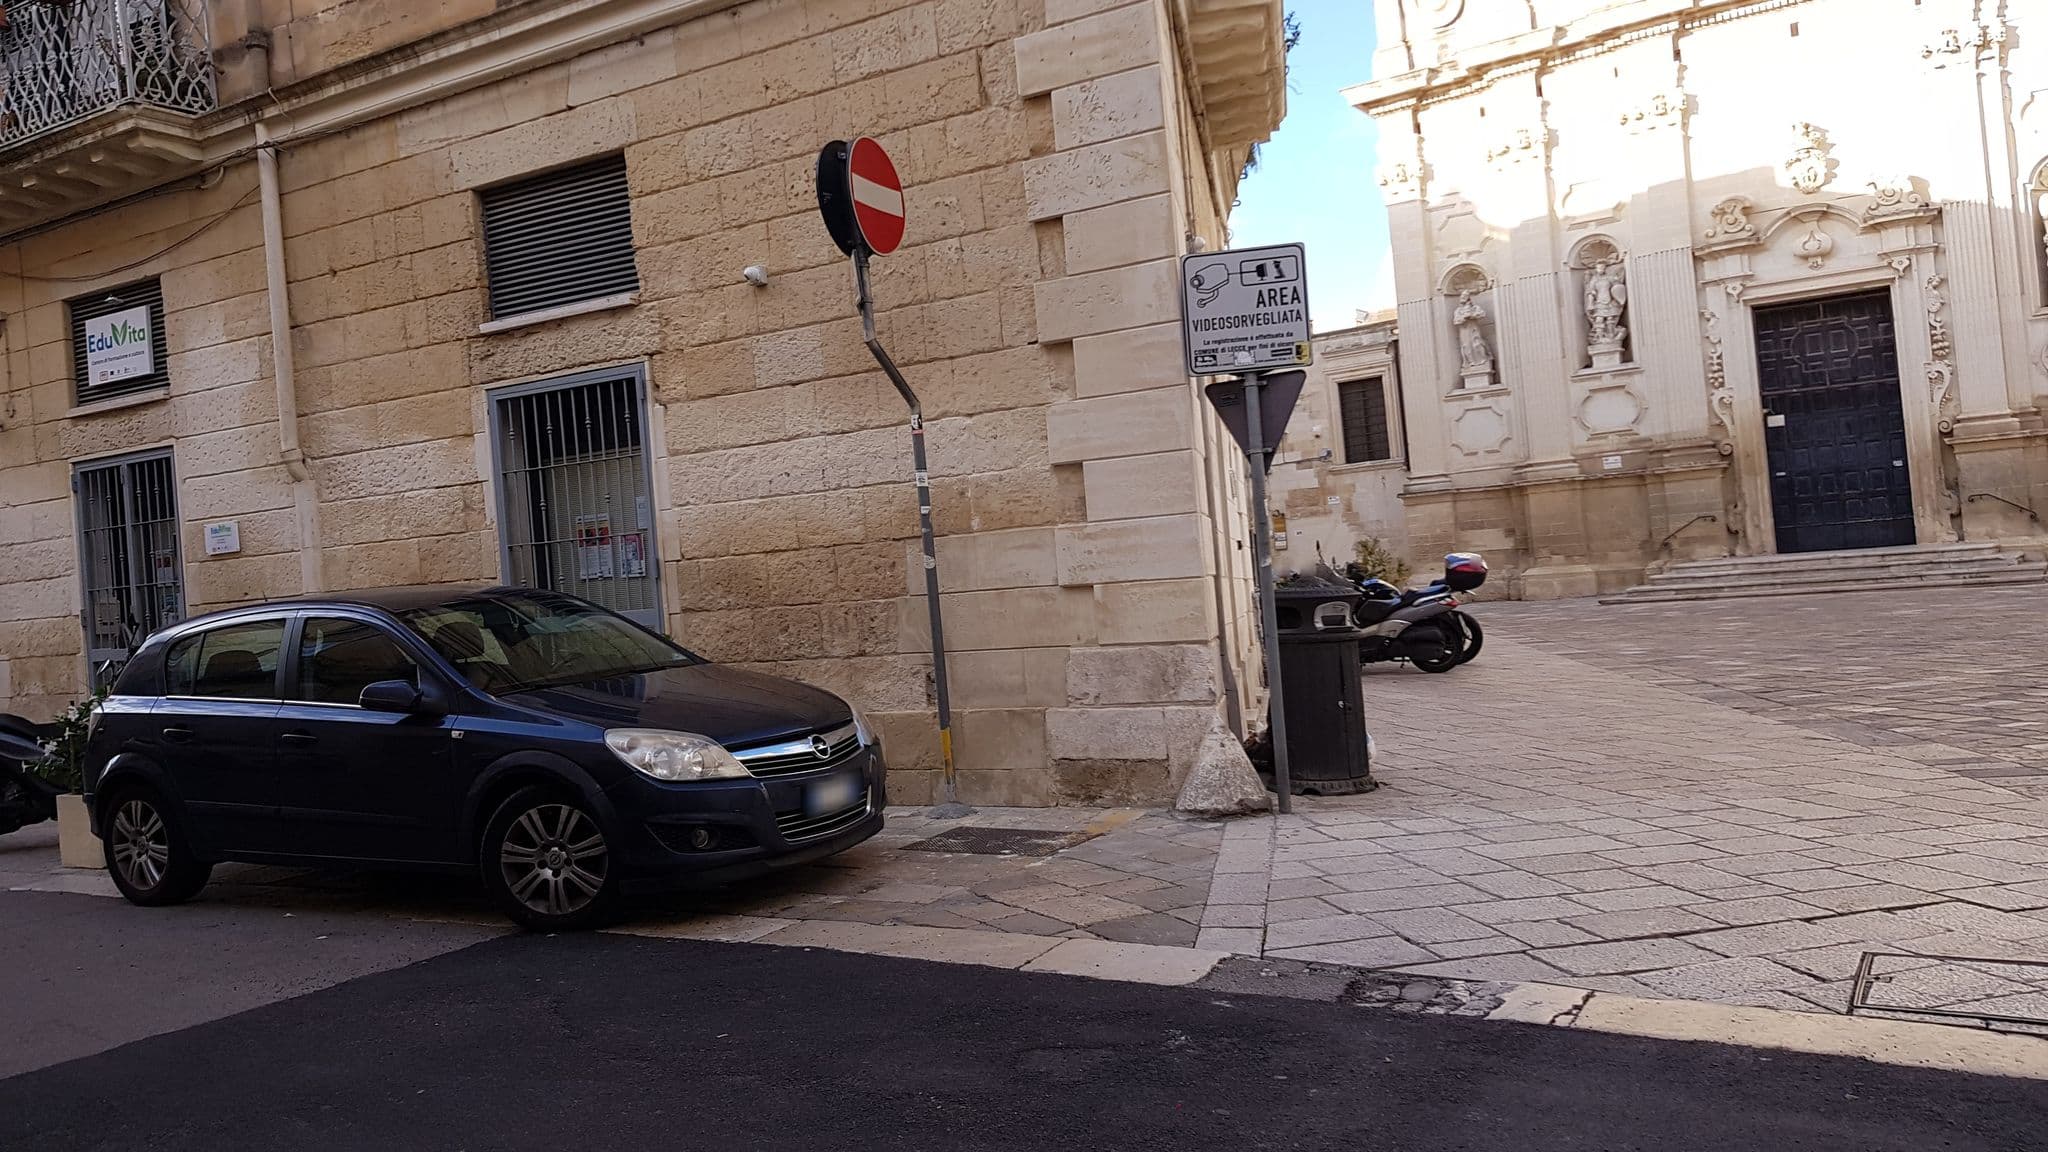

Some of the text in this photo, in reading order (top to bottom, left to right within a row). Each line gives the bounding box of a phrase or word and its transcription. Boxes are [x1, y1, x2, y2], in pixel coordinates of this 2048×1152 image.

[1256, 286, 1301, 308] AREA
[1192, 309, 1303, 332] VIDEOSORVEGLIATA
[88, 320, 146, 353] EduVita
[1211, 337, 1248, 345] registrazione
